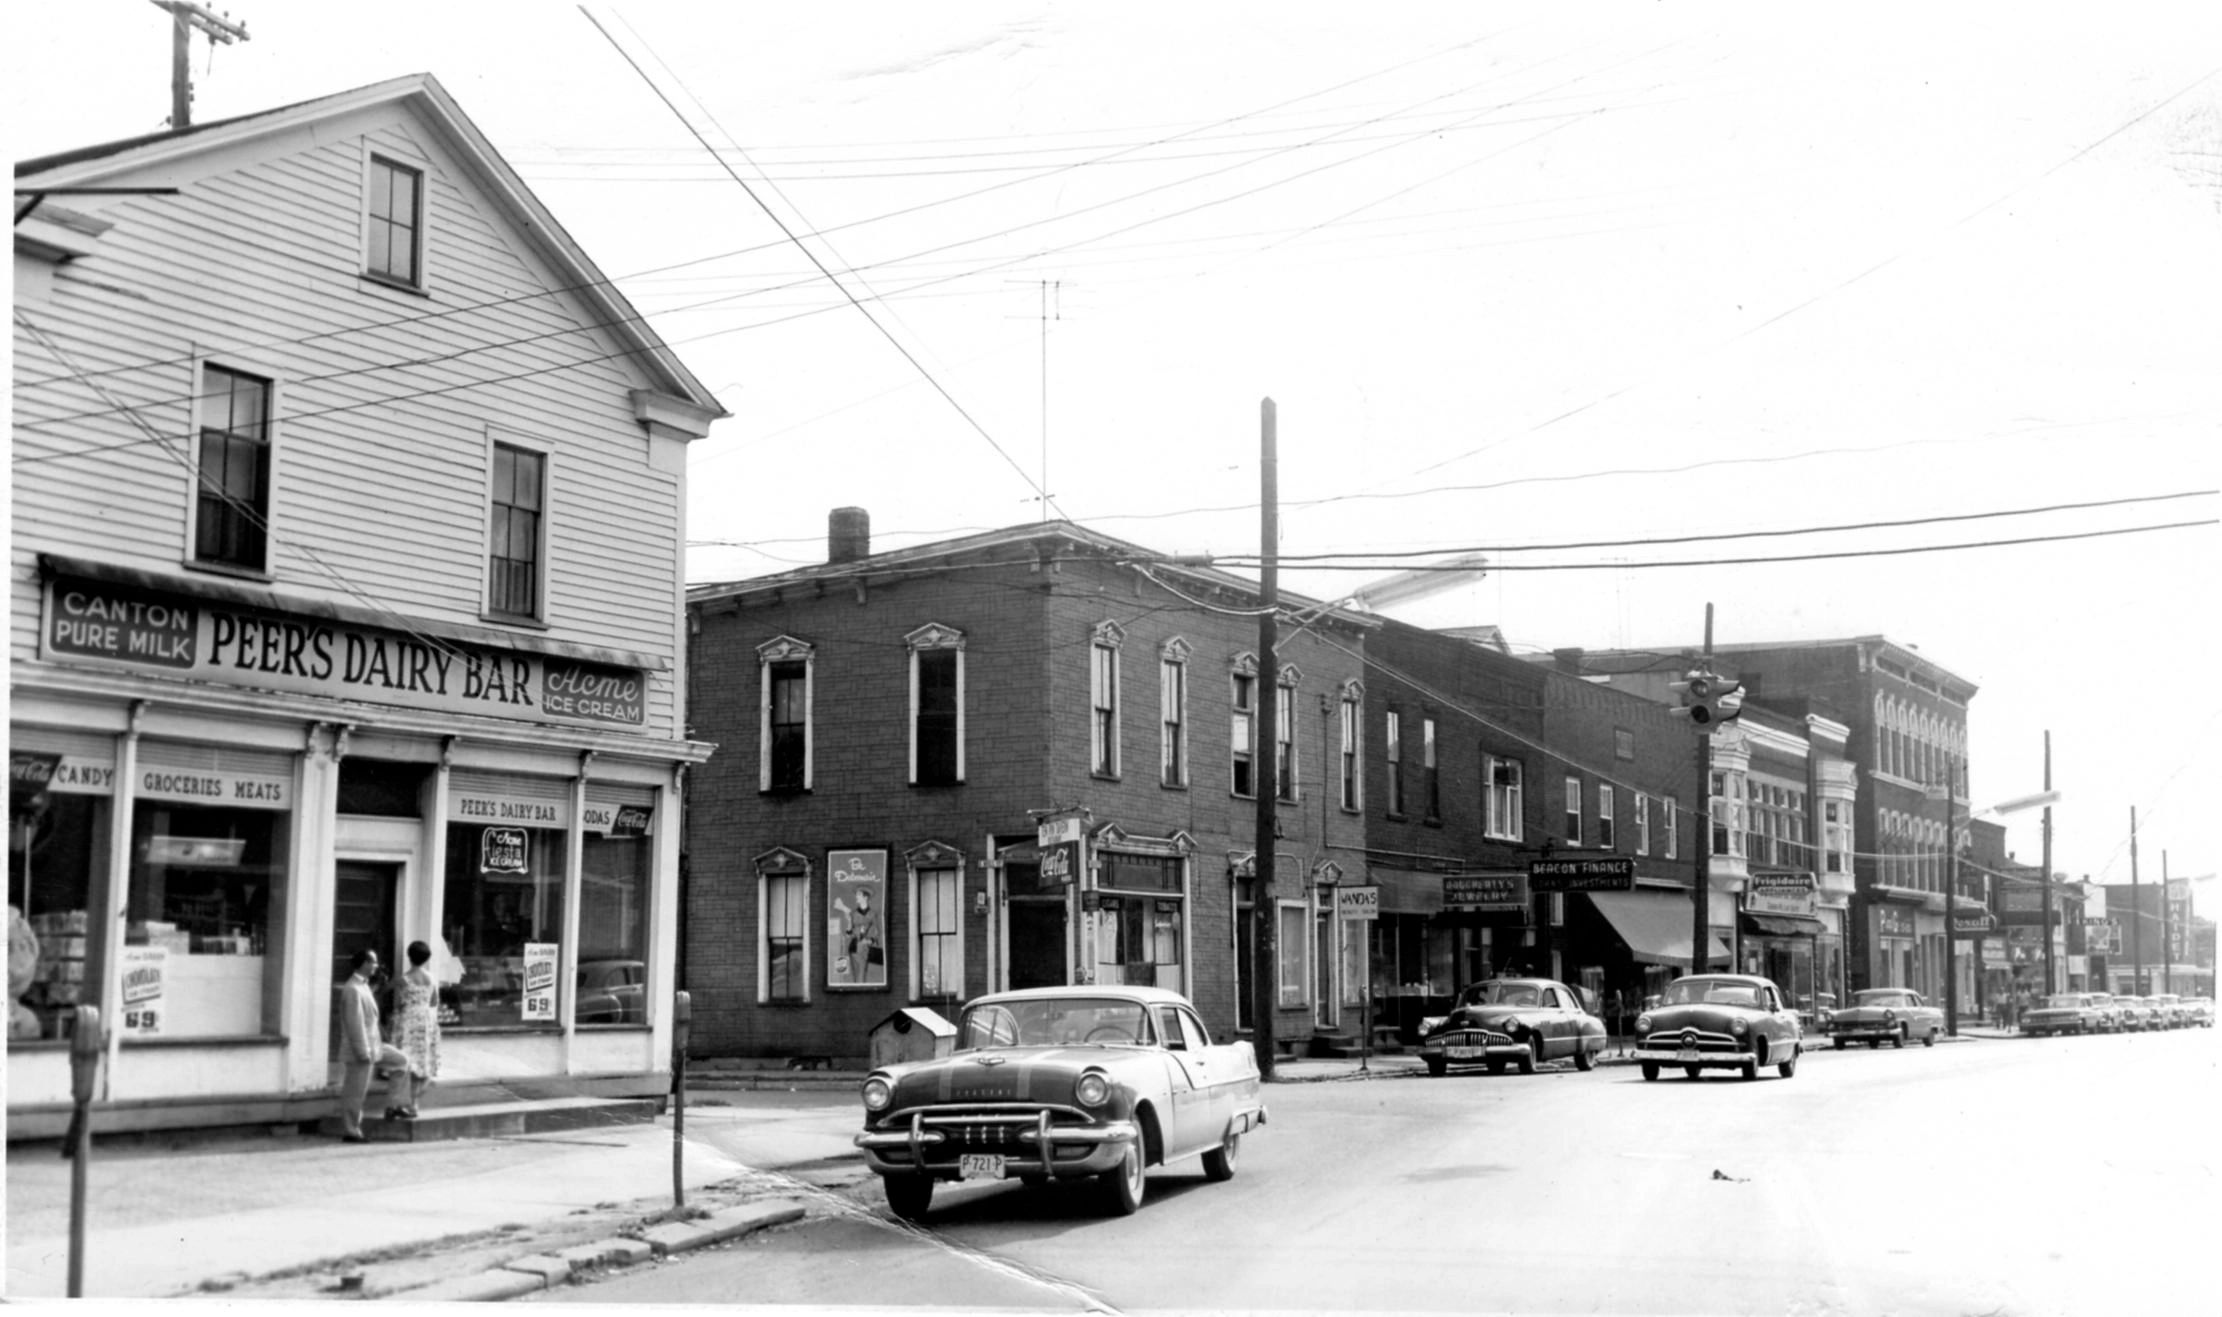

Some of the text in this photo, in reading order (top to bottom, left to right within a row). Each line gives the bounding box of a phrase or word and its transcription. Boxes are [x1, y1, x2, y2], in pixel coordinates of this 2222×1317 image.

[64, 591, 189, 631] CANTON
[55, 619, 191, 661] PURE MILK
[208, 611, 534, 706] PEER'S DAIRY BAR
[547, 665, 640, 702] Acme
[543, 693, 640, 721] ICE CREAM
[57, 764, 113, 787] CANDY
[143, 772, 282, 801] GROCERIES MEATS
[460, 798, 557, 821] PEER'S DAIRY BAR
[582, 809, 610, 825] ODAS
[1532, 861, 1628, 875] BEACON FINANCE
[972, 1157, 993, 1171] 721
